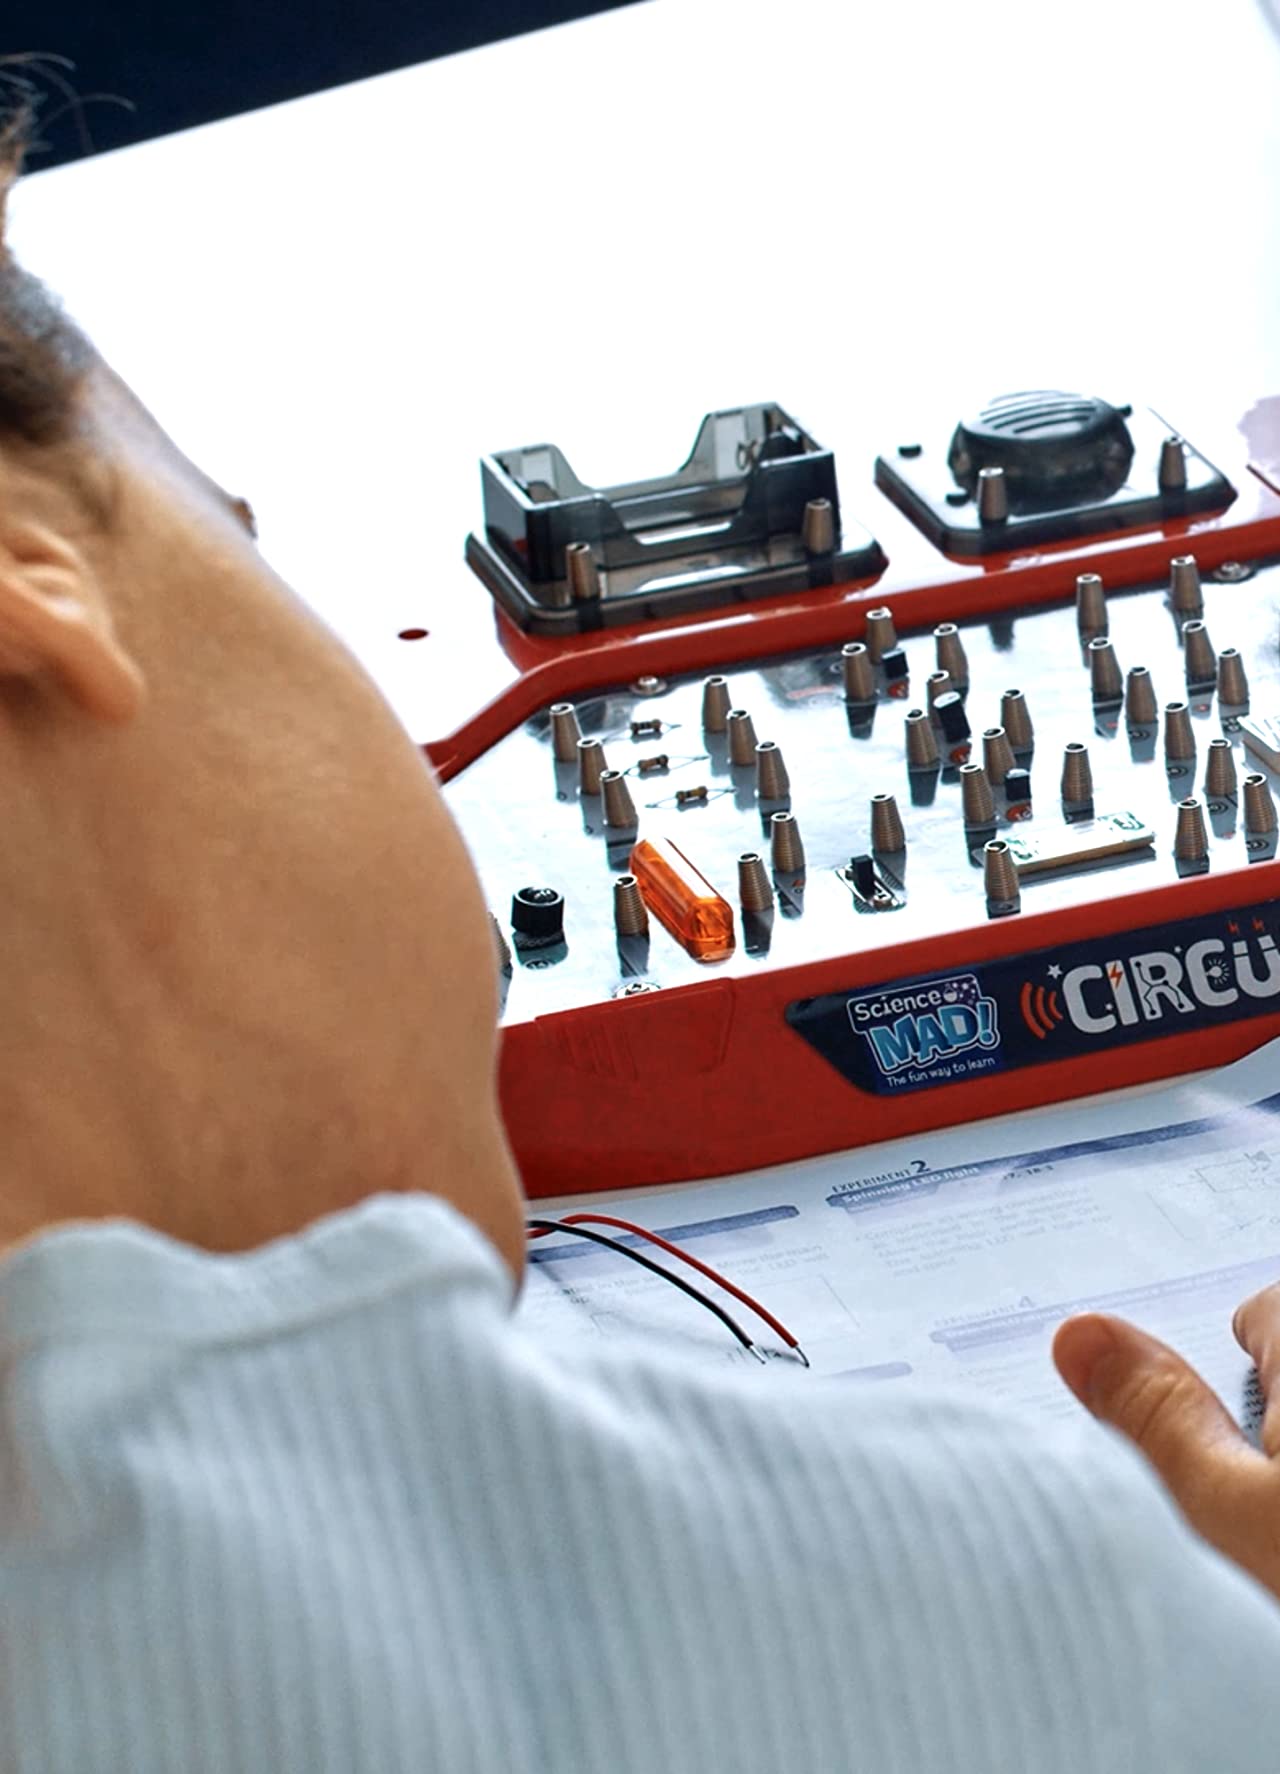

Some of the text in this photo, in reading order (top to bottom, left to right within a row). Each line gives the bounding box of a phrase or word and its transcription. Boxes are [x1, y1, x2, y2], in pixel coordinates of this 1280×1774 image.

[853, 988, 942, 1022] Science
[868, 1001, 996, 1071] MAD!
[886, 1057, 996, 1088] The fun way to learn
[832, 1160, 931, 1193] EXPERIMENT 2
